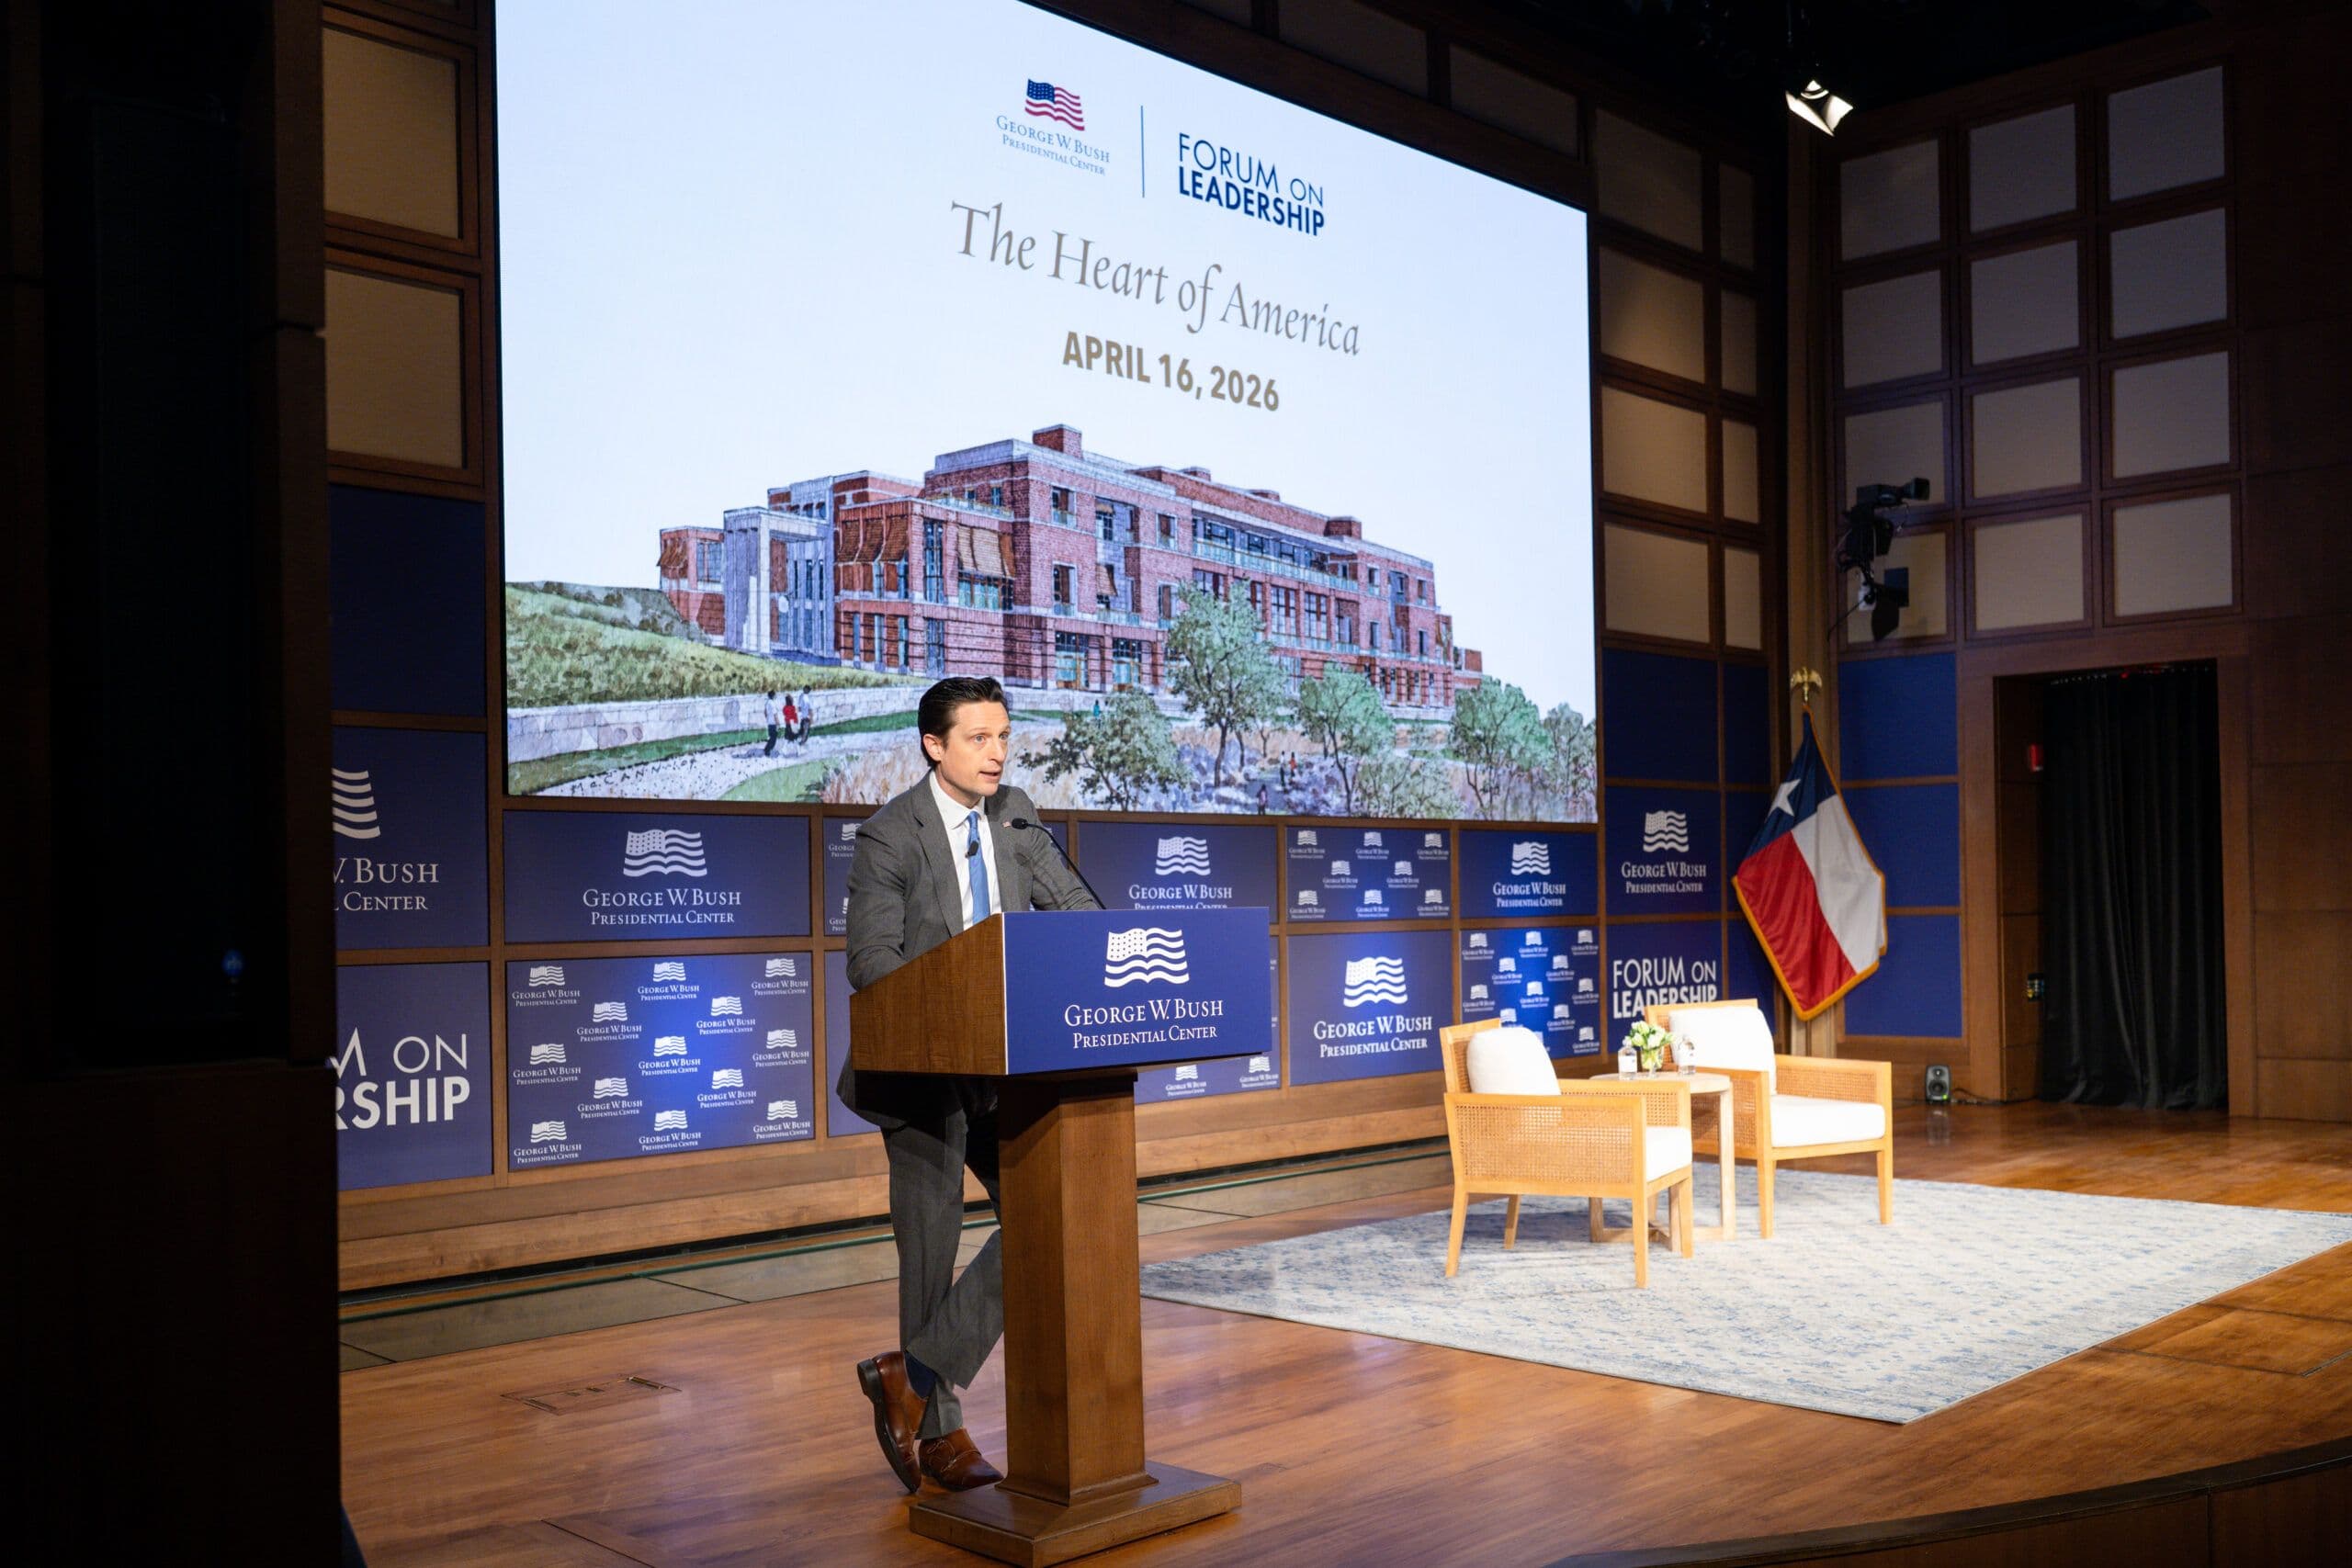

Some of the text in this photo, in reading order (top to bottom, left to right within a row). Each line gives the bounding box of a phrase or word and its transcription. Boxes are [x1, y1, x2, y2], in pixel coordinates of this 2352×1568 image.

[996, 115, 1110, 163] GEORGE W. BUSH
[1002, 134, 1105, 175] PRESIDENTIAL CENTER
[1179, 132, 1324, 208] FORUM ON
[1179, 166, 1325, 237] LEADERSHIP
[952, 200, 1361, 356] The Heart of America
[1063, 332, 1279, 412] APRIL 16, 2026
[354, 858, 441, 884] BUSH
[1622, 862, 1666, 878] GEORGE
[1679, 862, 1706, 877] BUSH
[1129, 885, 1232, 899] GEORGE W. BUSH
[1493, 882, 1530, 896] GEORGE
[1543, 882, 1566, 895] BUSH
[1626, 881, 1702, 893] PRESIDENTIAL CENTER
[344, 892, 429, 911] CENTER
[583, 888, 741, 907] GEORGE W. BUSH
[1497, 897, 1563, 908] PRESIDENTIAL CENTER
[592, 910, 734, 925] PRESIDENTIAL CENTER
[1613, 957, 1716, 989] FORUM ON
[559, 989, 580, 998] BUSH
[1065, 998, 1223, 1026] GEORGE W. BUSH
[577, 1027, 609, 1035] GEORGE
[621, 1024, 641, 1032] BUSH
[1314, 1015, 1431, 1040] GEORGE W. BUSH
[1073, 1025, 1217, 1048] PRESIDENTIAL CENTER
[393, 1033, 467, 1074] ON
[1320, 1037, 1427, 1058] PRESIDENTIAL CENTER
[514, 1069, 548, 1077] GEORGE
[560, 1066, 581, 1075] BUSH
[639, 1061, 670, 1069] GEORGE
[681, 1058, 700, 1066] BUSH
[697, 1093, 727, 1101] GEORGE
[578, 1103, 610, 1111] GEORGE
[753, 1124, 782, 1133] GEORGE
[639, 1135, 670, 1144] GEORGE
[681, 1132, 701, 1140] BUSH
[514, 1147, 548, 1156] GEORGE
[560, 1144, 582, 1152] BUSH
